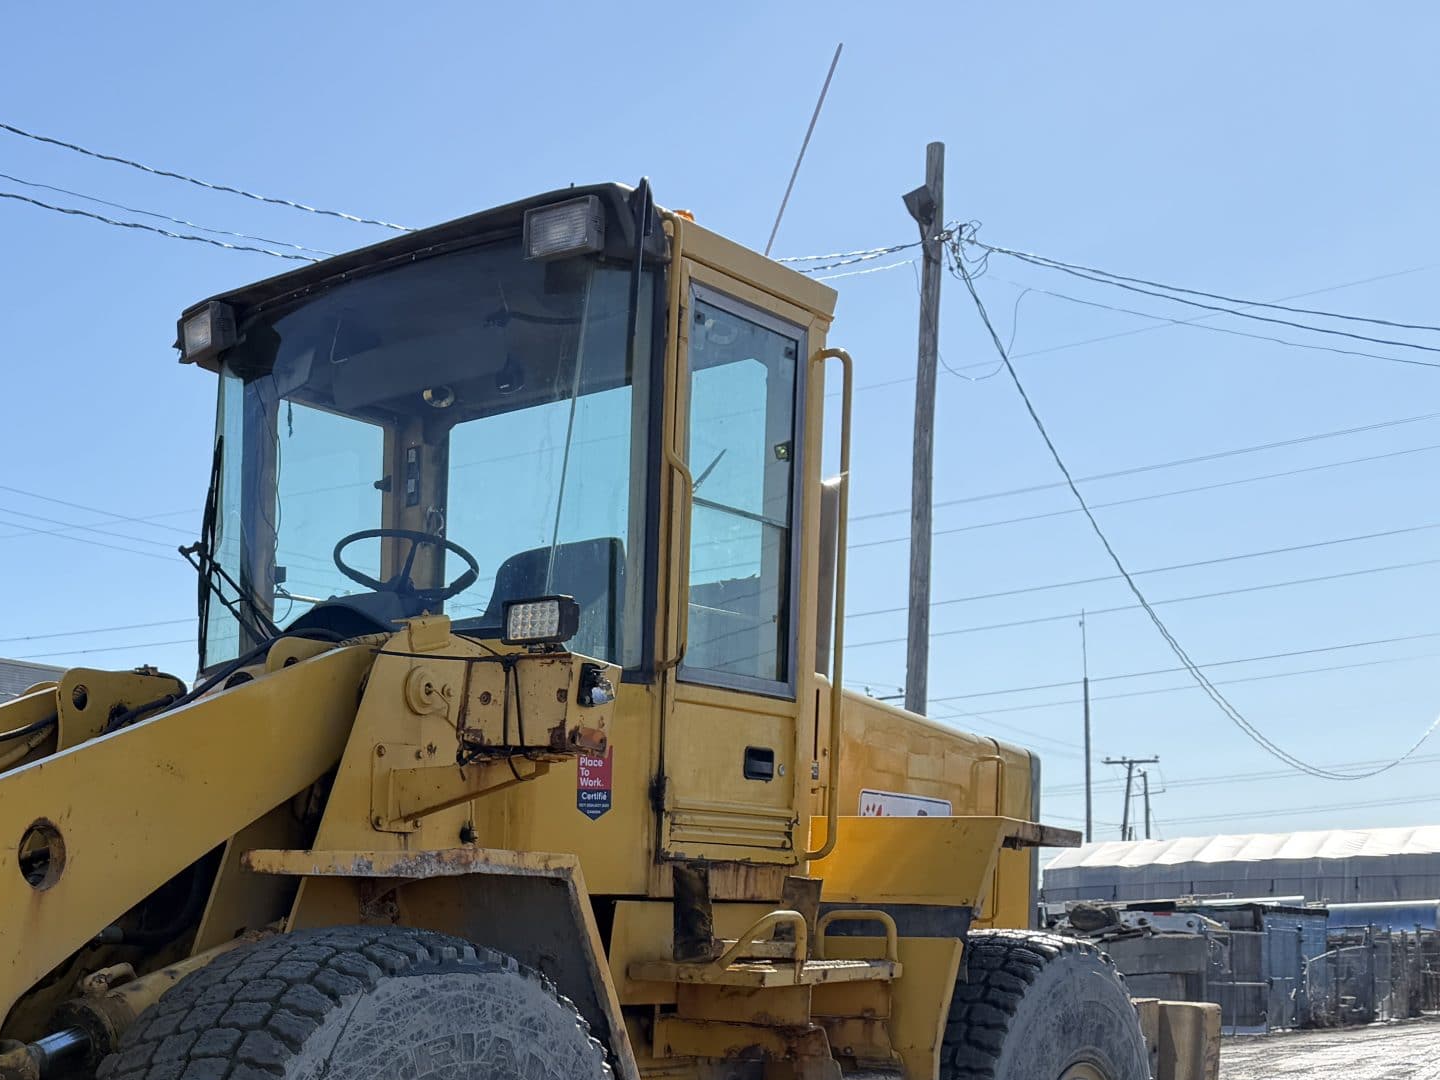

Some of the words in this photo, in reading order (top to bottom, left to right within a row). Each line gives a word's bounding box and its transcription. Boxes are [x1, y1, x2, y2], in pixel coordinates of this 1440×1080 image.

[580, 756, 603, 767] Place
[579, 767, 590, 777] To
[581, 791, 607, 801] Certifié
